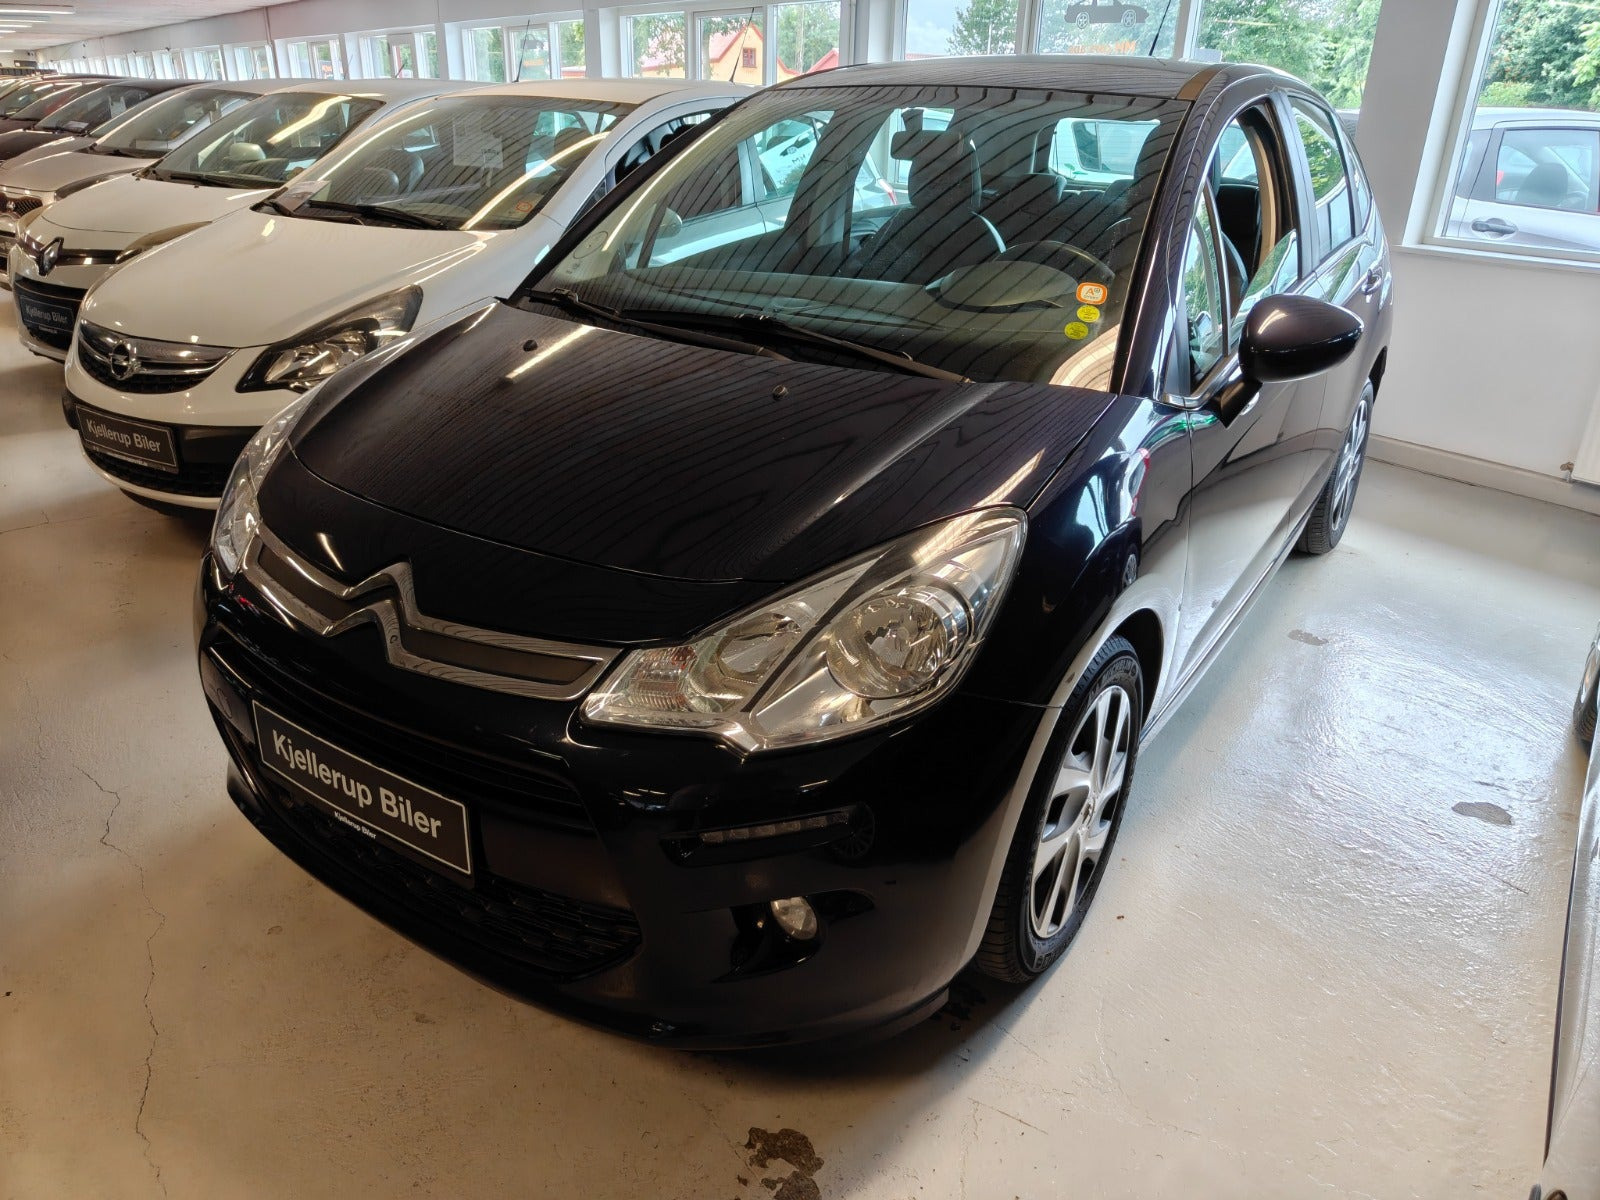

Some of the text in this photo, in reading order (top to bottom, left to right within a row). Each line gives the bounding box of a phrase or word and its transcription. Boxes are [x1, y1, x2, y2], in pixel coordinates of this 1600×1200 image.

[86, 419, 161, 453] Kjellerup Biler
[272, 729, 442, 838] Kjellerup Biler
